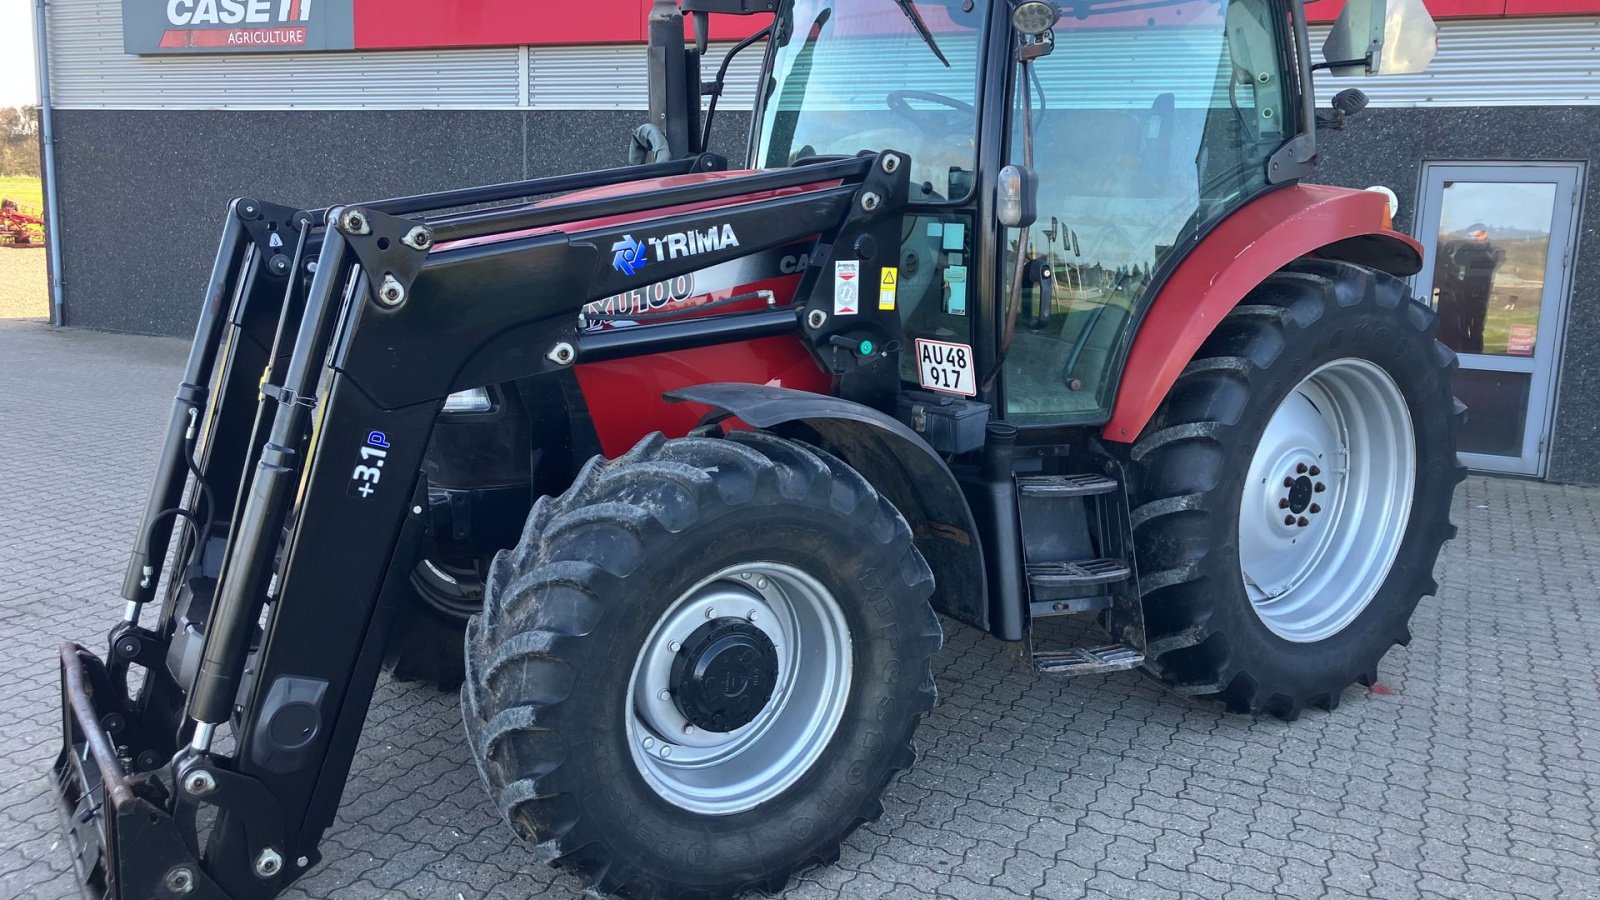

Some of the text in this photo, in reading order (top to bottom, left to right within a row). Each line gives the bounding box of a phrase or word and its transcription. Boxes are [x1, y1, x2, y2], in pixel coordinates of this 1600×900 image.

[166, 0, 272, 25] CASE
[227, 30, 303, 44] AGRICULTURE
[648, 223, 740, 262] TRIMA
[582, 272, 694, 329] XU100
[930, 366, 961, 389] 917
